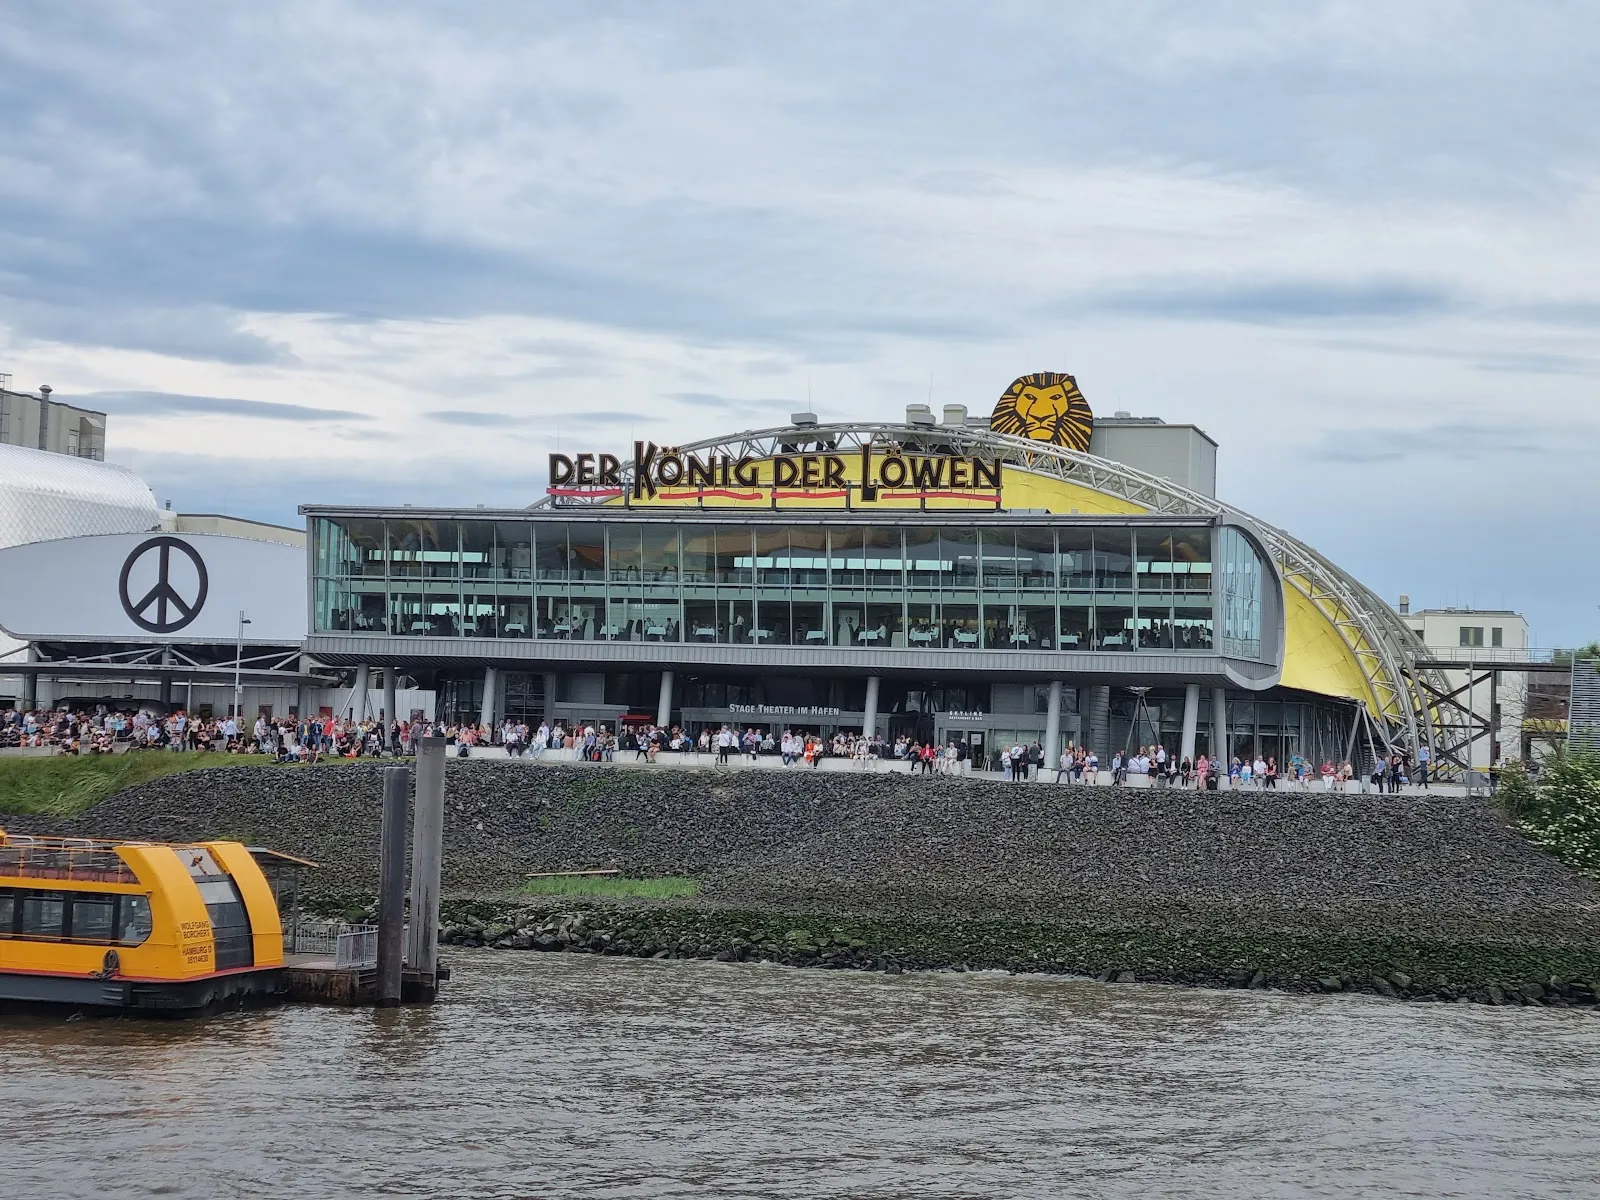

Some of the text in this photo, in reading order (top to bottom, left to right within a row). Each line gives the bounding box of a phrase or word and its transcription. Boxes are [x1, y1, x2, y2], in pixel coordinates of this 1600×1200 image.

[549, 440, 1003, 502] DER KÖNIG DER LÖWEN
[729, 703, 756, 713] STAGE
[758, 704, 795, 715] THEATER
[811, 705, 840, 716] HAFEN
[180, 920, 210, 930] WOLFGANG
[183, 929, 210, 939] BORCHERT
[182, 946, 207, 956] HAMBURG
